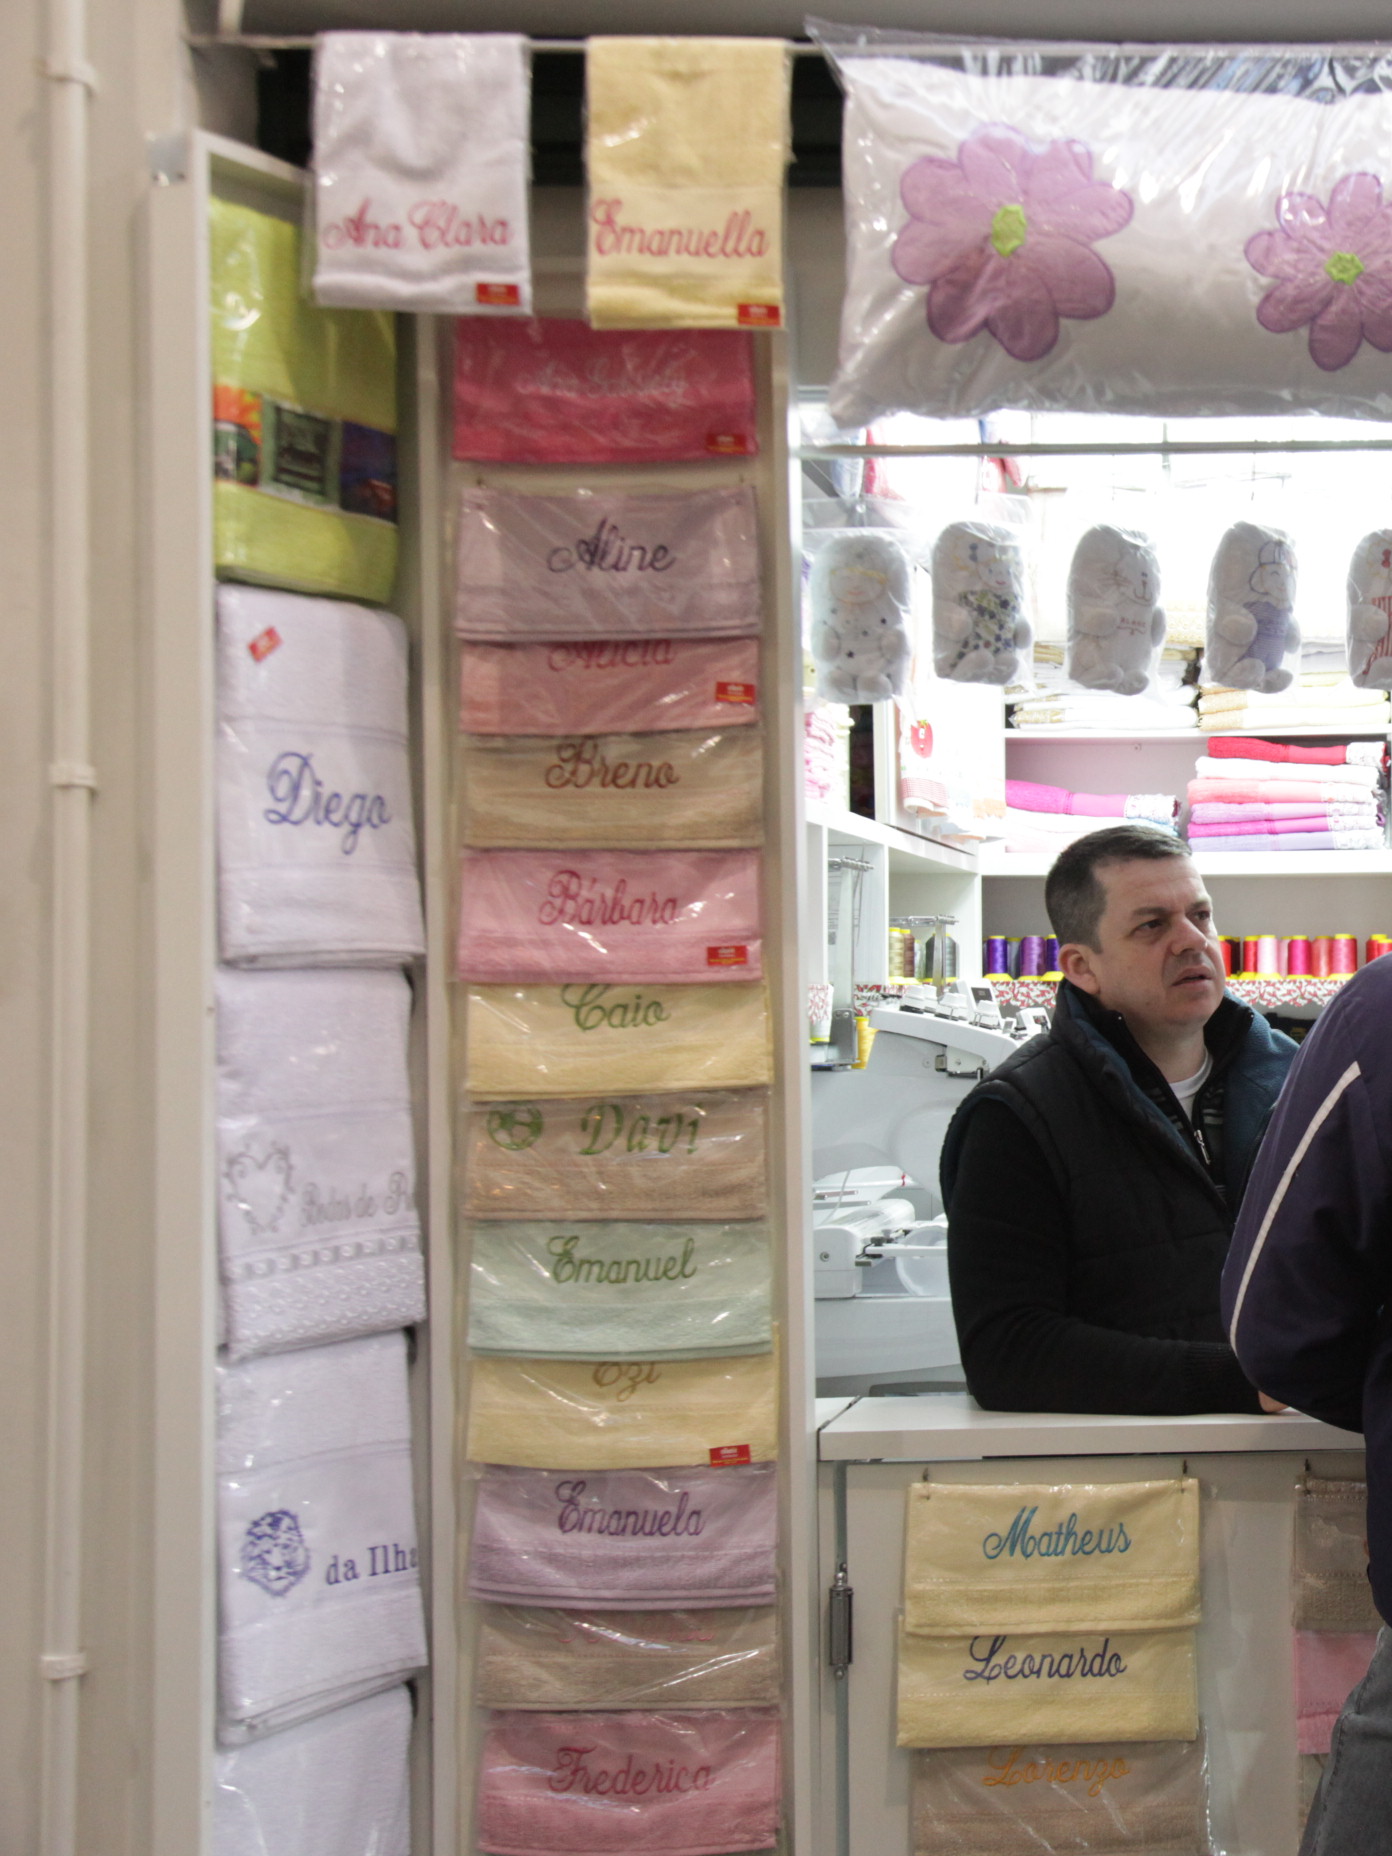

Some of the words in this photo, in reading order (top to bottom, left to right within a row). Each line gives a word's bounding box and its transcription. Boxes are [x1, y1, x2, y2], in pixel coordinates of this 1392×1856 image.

[322, 197, 405, 250] Ana
[408, 198, 514, 251] Clara
[589, 199, 770, 260] Emanuella
[547, 518, 677, 573] Aline
[545, 737, 681, 791] Breno
[263, 751, 392, 856] Diego
[561, 983, 672, 1031] Caio
[579, 1102, 701, 1157] Davi
[547, 1235, 697, 1284] Emanuel
[555, 1480, 706, 1537] Emanuela
[982, 1506, 1132, 1561] Matheus
[326, 1554, 360, 1586] da
[963, 1635, 1128, 1686] Leonardo
[982, 1748, 1132, 1798] Lorenzo
